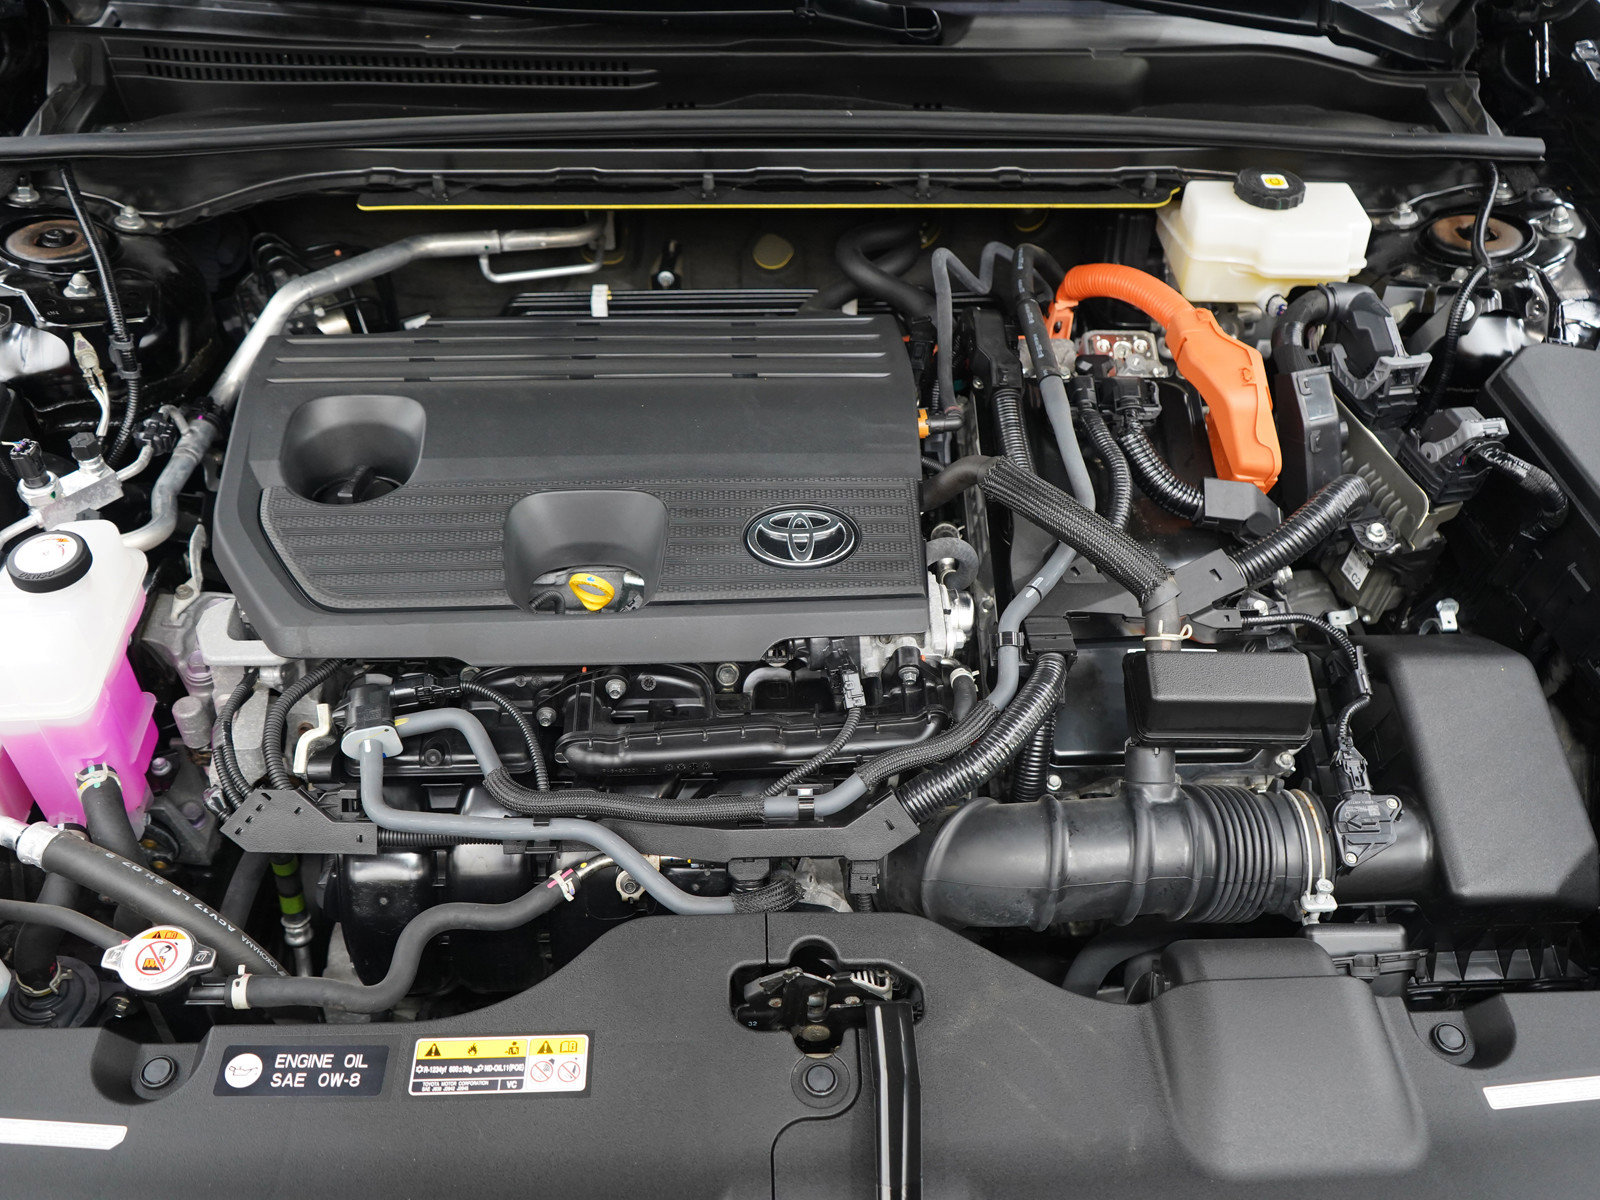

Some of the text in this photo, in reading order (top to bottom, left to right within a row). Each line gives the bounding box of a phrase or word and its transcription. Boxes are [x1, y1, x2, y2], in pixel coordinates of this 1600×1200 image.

[194, 902, 236, 932] ACV17
[241, 934, 278, 971] YOKOHAMA
[275, 1053, 368, 1069] ENGINE OIL
[270, 1072, 361, 1088] SAE 0W-8
[506, 1080, 518, 1089] VC
